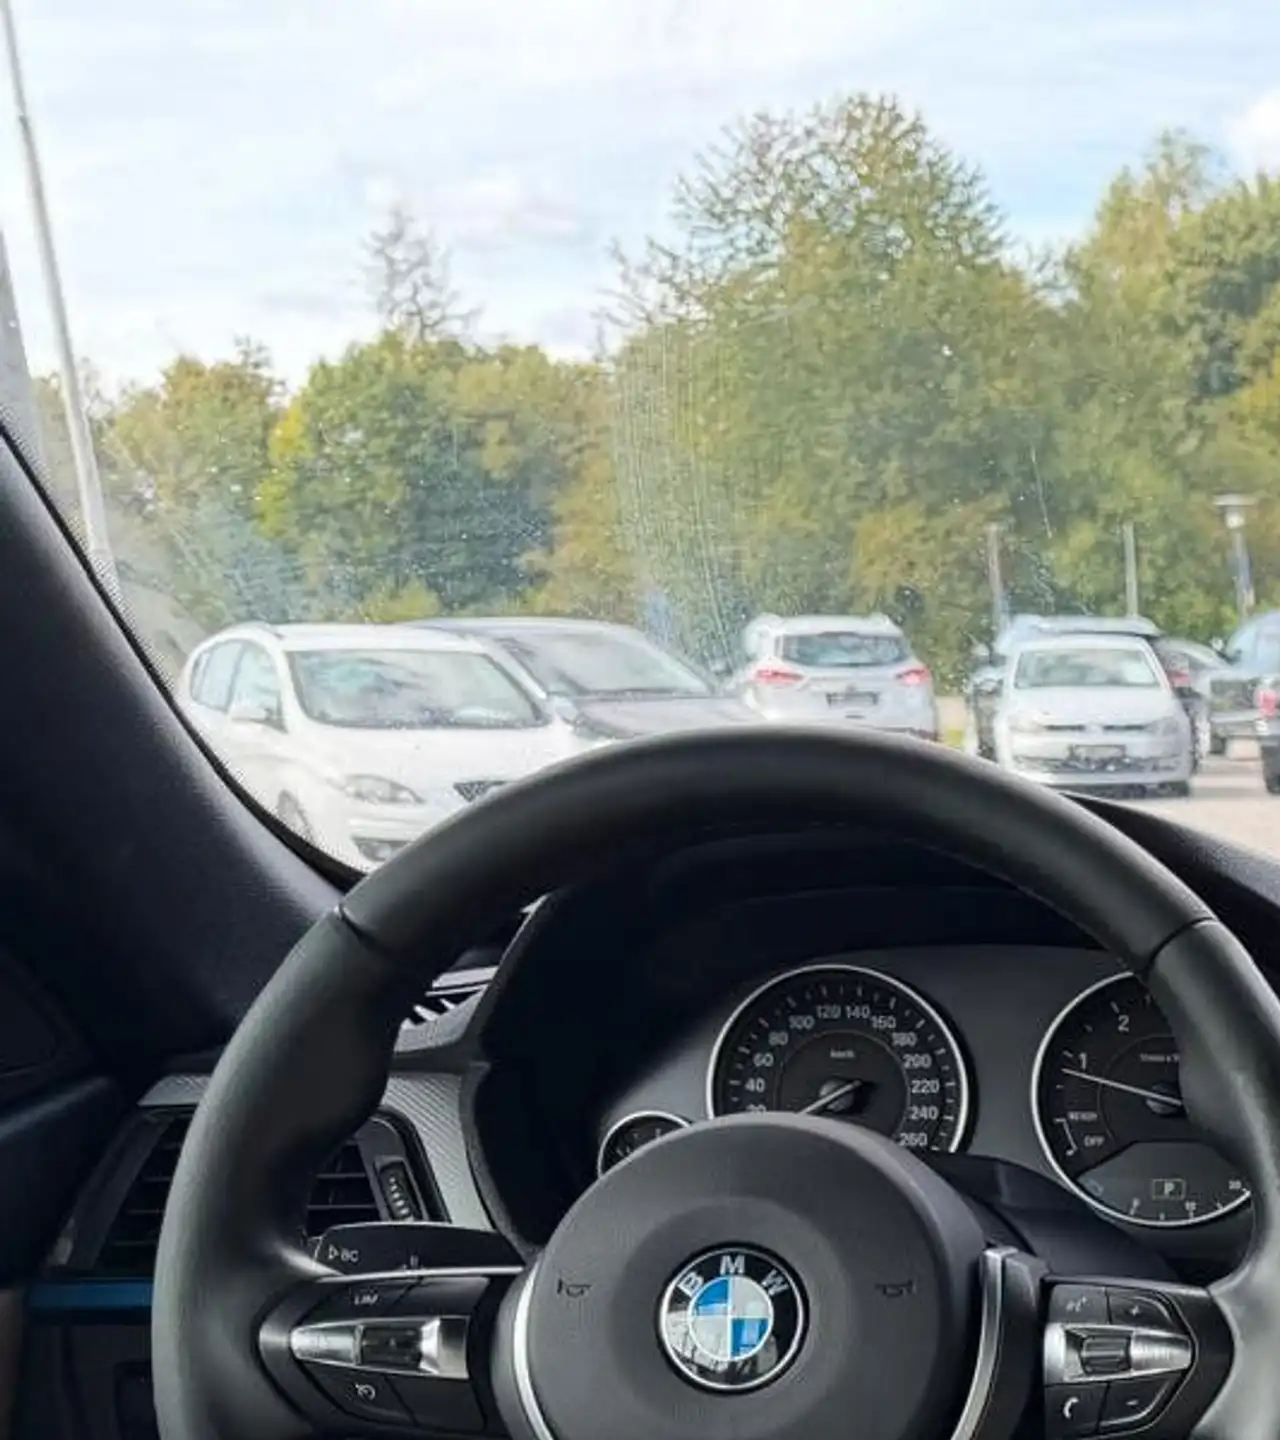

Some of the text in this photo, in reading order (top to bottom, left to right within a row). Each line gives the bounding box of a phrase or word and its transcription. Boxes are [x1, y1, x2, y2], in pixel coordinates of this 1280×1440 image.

[815, 1003, 842, 1018] 120
[845, 1004, 871, 1019] 140
[788, 1015, 815, 1029] 100
[1117, 1015, 1130, 1033] 2
[768, 1031, 788, 1046] 80
[752, 1052, 774, 1067] 60
[902, 1053, 932, 1069] 200
[1078, 1053, 1088, 1070] 1
[745, 1078, 766, 1093] 40
[911, 1079, 940, 1094] 220
[909, 1106, 939, 1121] 240
[899, 1132, 928, 1148] 260
[1083, 1134, 1105, 1148] OFF
[675, 1254, 790, 1297] BMW
